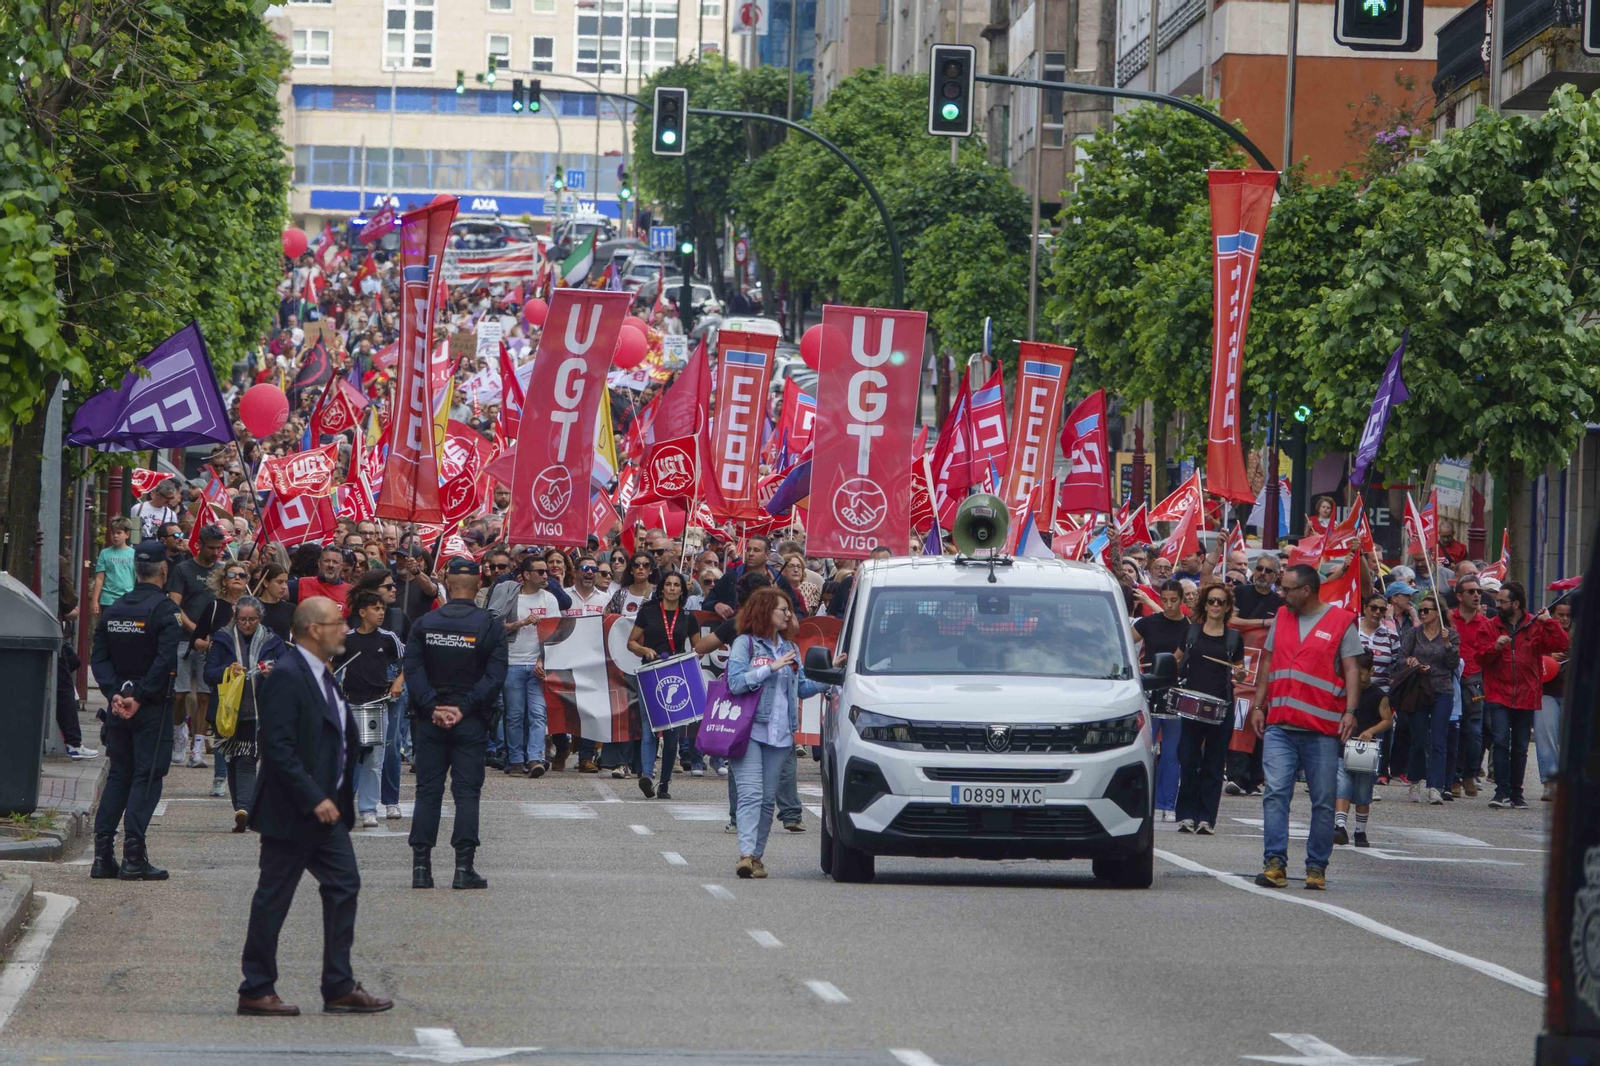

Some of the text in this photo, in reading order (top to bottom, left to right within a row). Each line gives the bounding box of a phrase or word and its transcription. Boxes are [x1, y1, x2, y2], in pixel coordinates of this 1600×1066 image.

[471, 198, 499, 211] AXA
[550, 303, 603, 462] UGT
[846, 315, 896, 476] UGT
[721, 375, 754, 491] CCOO
[444, 438, 470, 467] UG
[1016, 386, 1048, 501] CCOO
[293, 455, 328, 477] UGT
[655, 453, 685, 480] UGT
[534, 521, 563, 537] VIGO
[838, 535, 878, 550] VIGO
[426, 633, 466, 642] POLICIA
[426, 639, 475, 649] NACIONAL
[753, 658, 768, 666] UGT
[963, 788, 1005, 804] 0899
[1011, 788, 1042, 804] MXC
